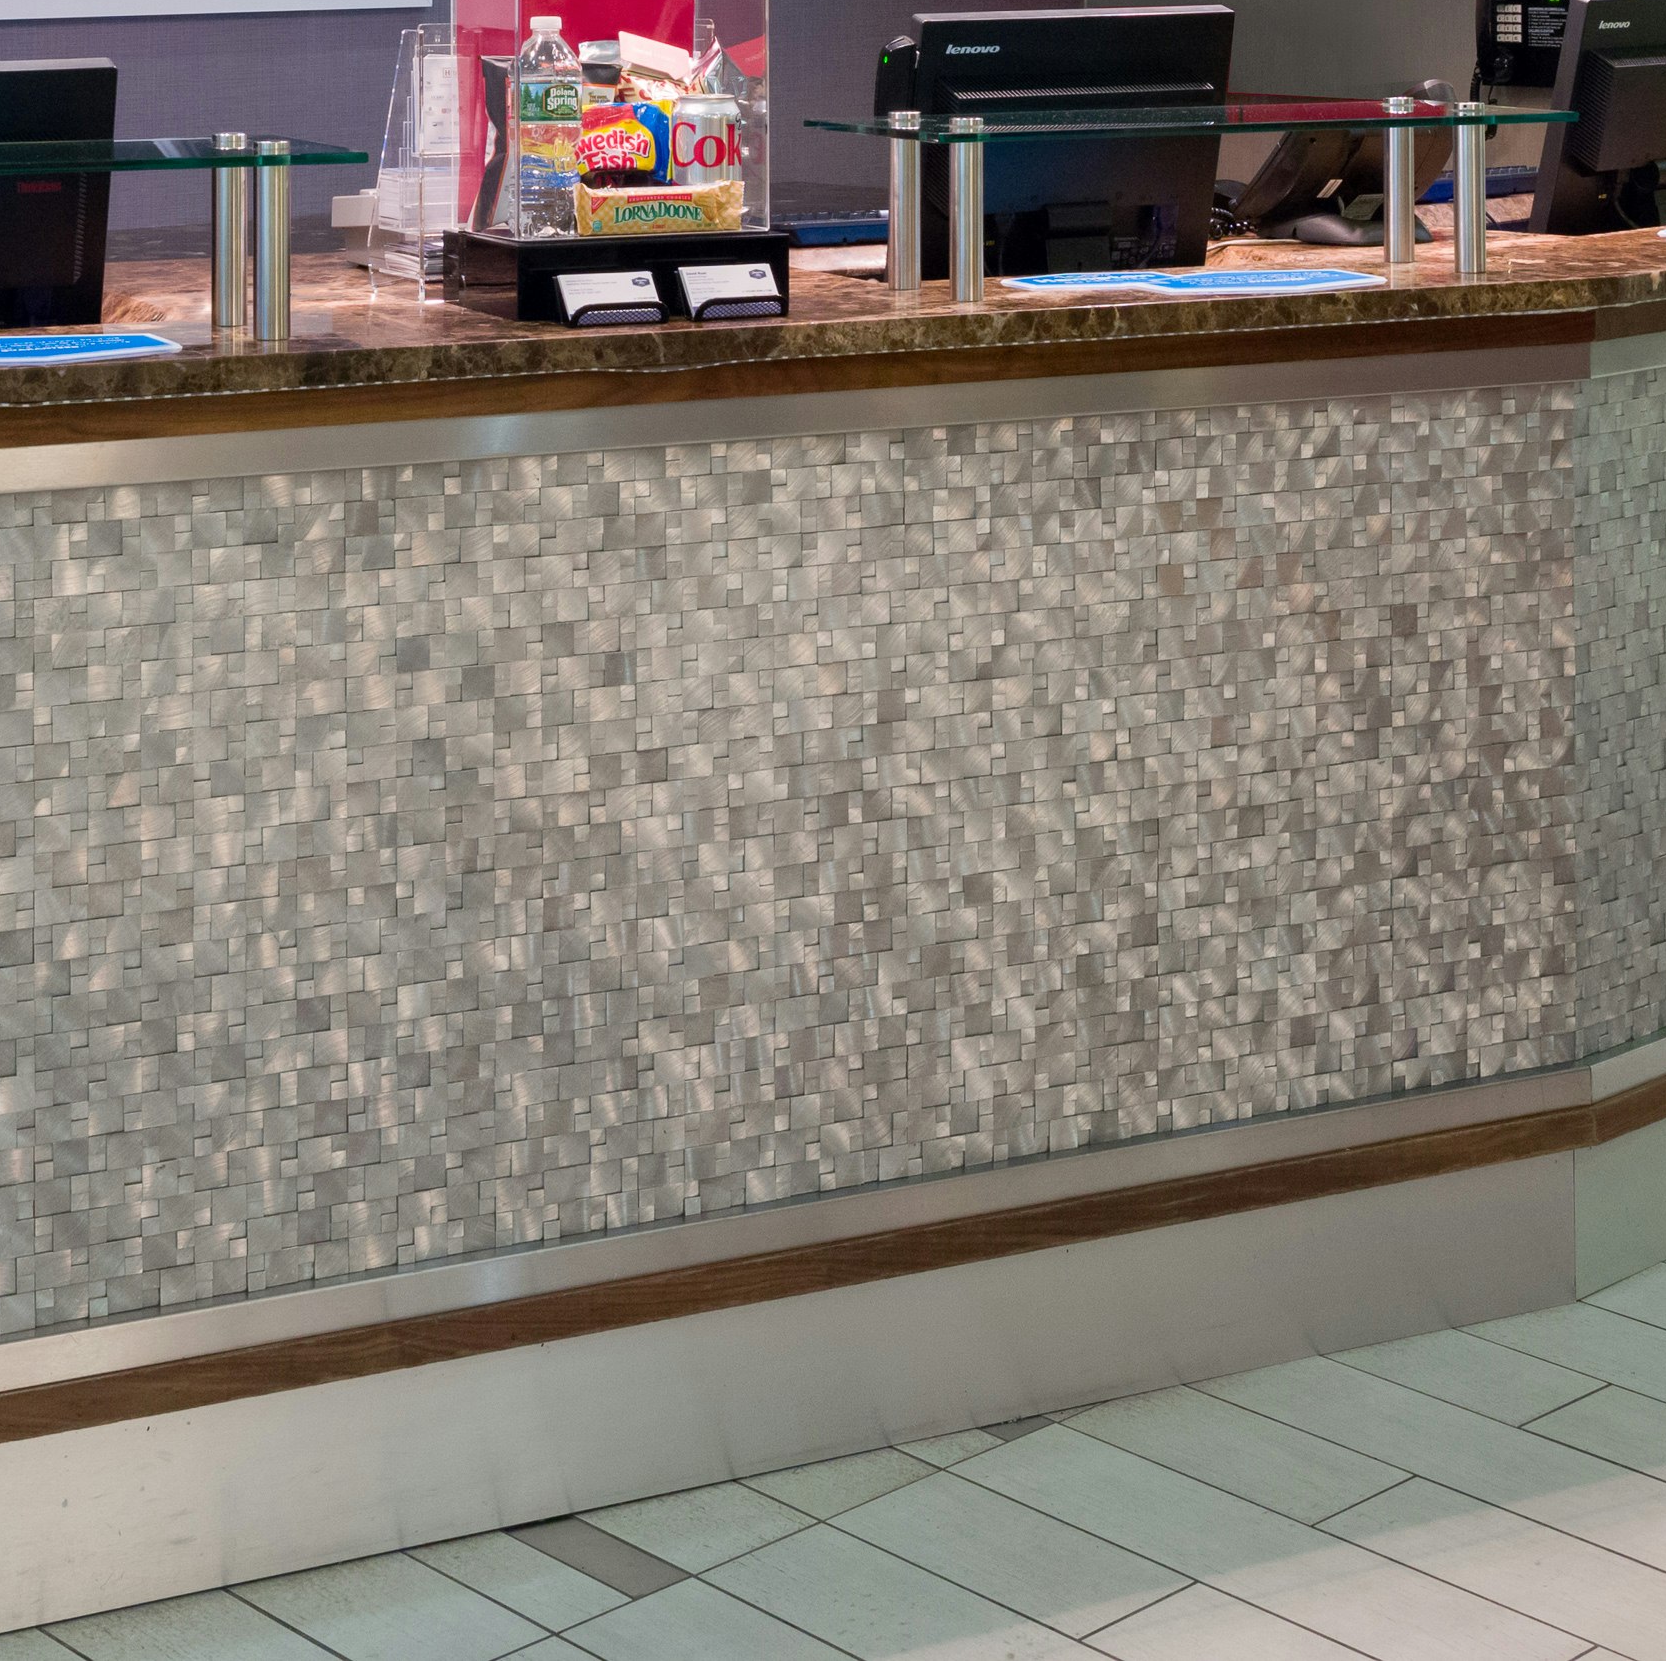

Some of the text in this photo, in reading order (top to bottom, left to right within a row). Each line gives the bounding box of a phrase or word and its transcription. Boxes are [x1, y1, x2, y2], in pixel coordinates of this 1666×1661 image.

[1598, 20, 1631, 29] lenovo
[945, 44, 1001, 55] lenovo
[550, 87, 576, 98] Poland
[547, 96, 578, 111] Spring
[583, 150, 636, 171] Fish
[614, 204, 657, 225] LORNA
[657, 201, 703, 223] DOONE
